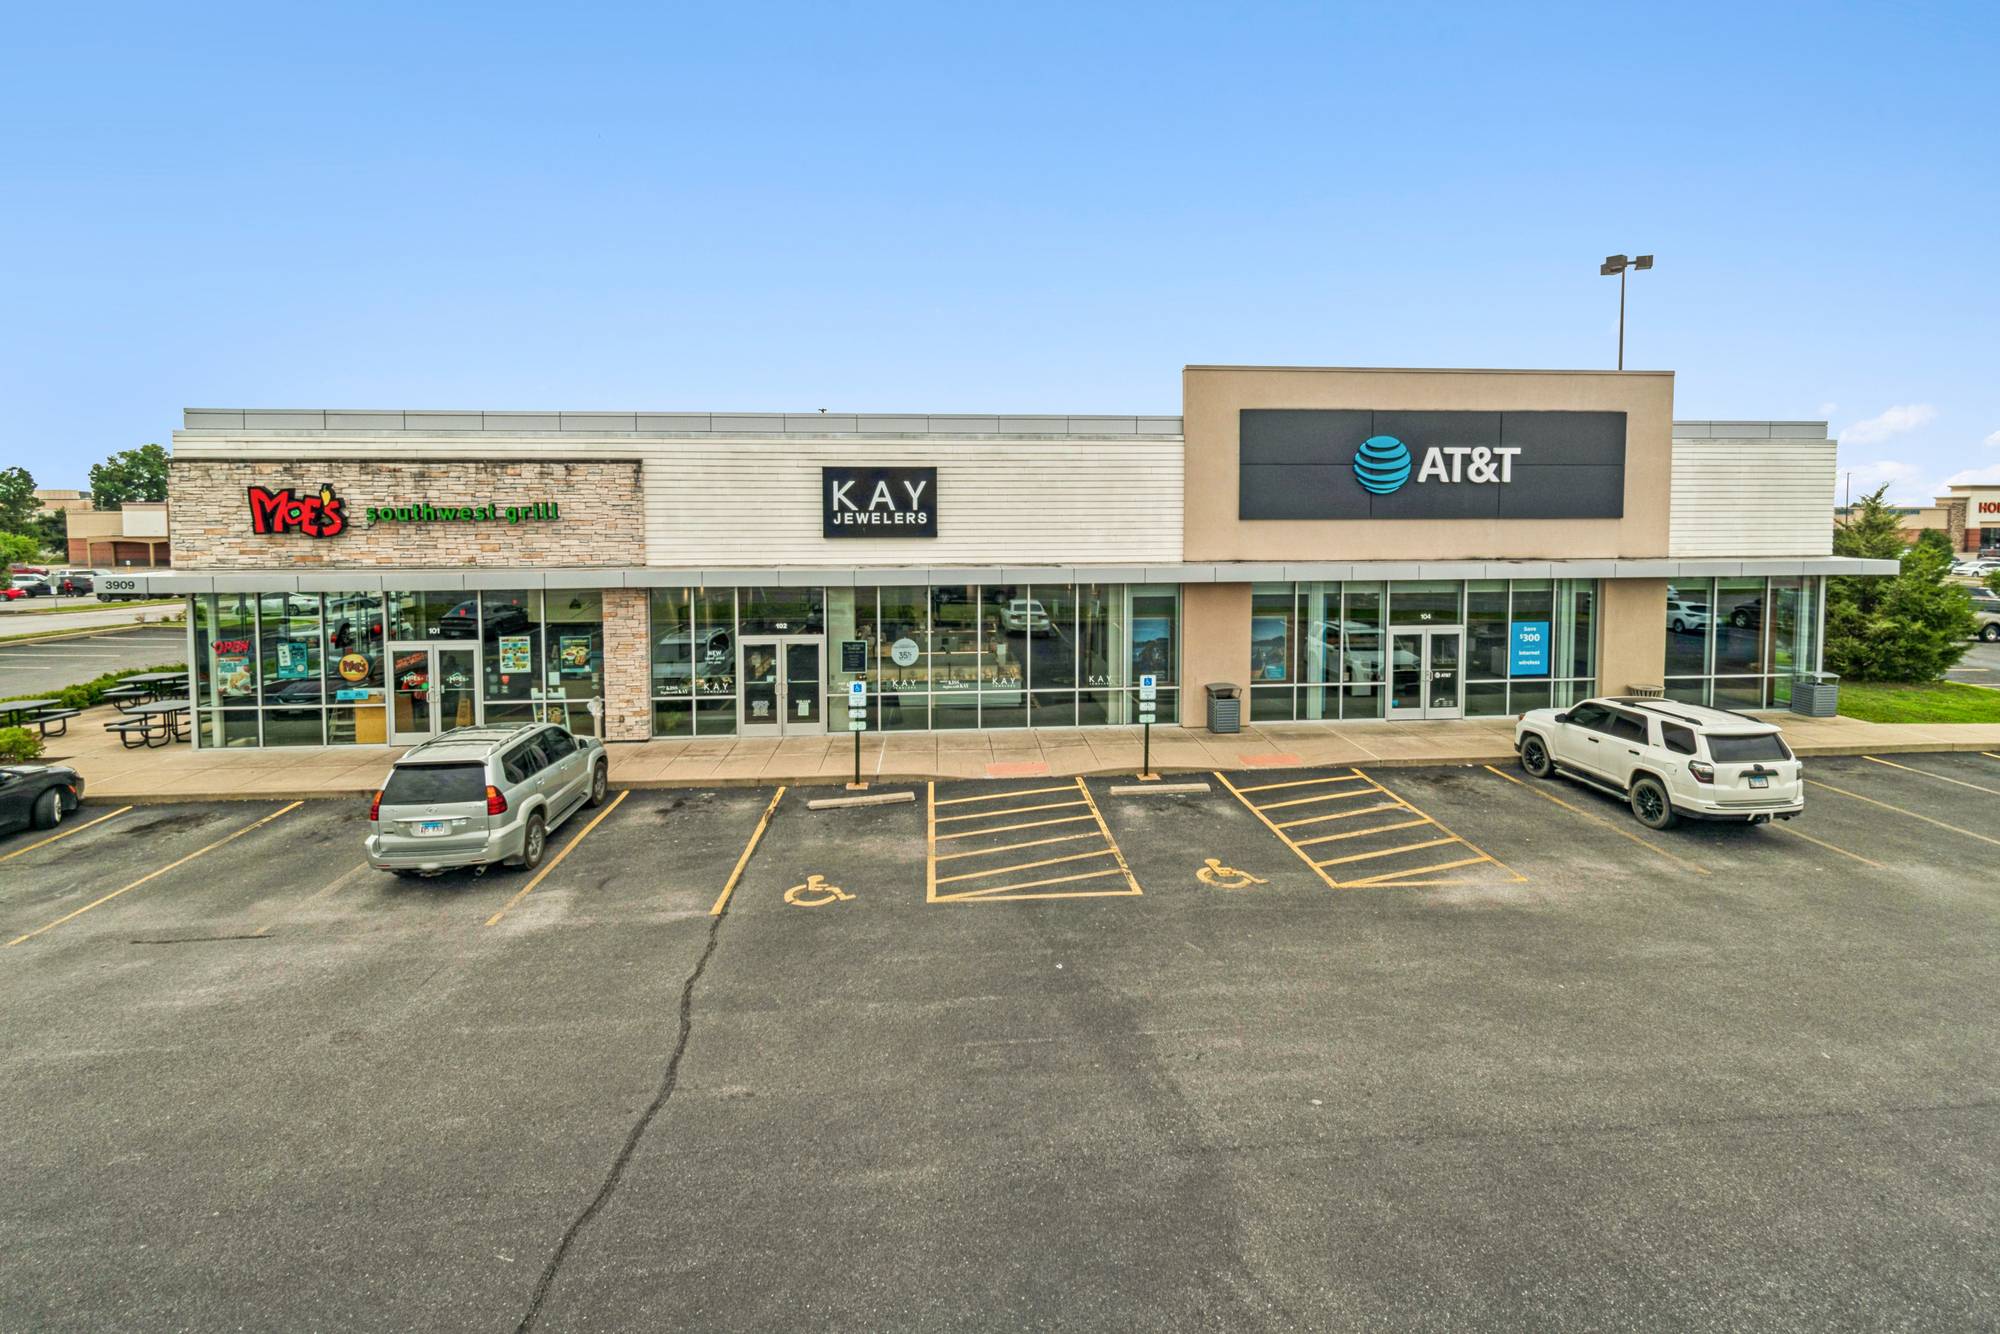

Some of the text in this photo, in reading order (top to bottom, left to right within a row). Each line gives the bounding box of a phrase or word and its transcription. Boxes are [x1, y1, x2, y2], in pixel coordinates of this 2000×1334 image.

[1417, 446, 1522, 484] AT&T
[832, 480, 927, 511] KAY
[366, 502, 497, 523] southwest
[504, 502, 559, 524] grill
[833, 512, 928, 525] JEWELERS
[105, 580, 135, 590] 3909
[428, 627, 441, 635] 101
[1519, 633, 1541, 642] $300
[212, 639, 250, 655] OPEN
[892, 679, 917, 688] KAY
[992, 677, 1016, 685] KAY
[1088, 675, 1112, 683] KAY
[703, 682, 729, 691] KAY
